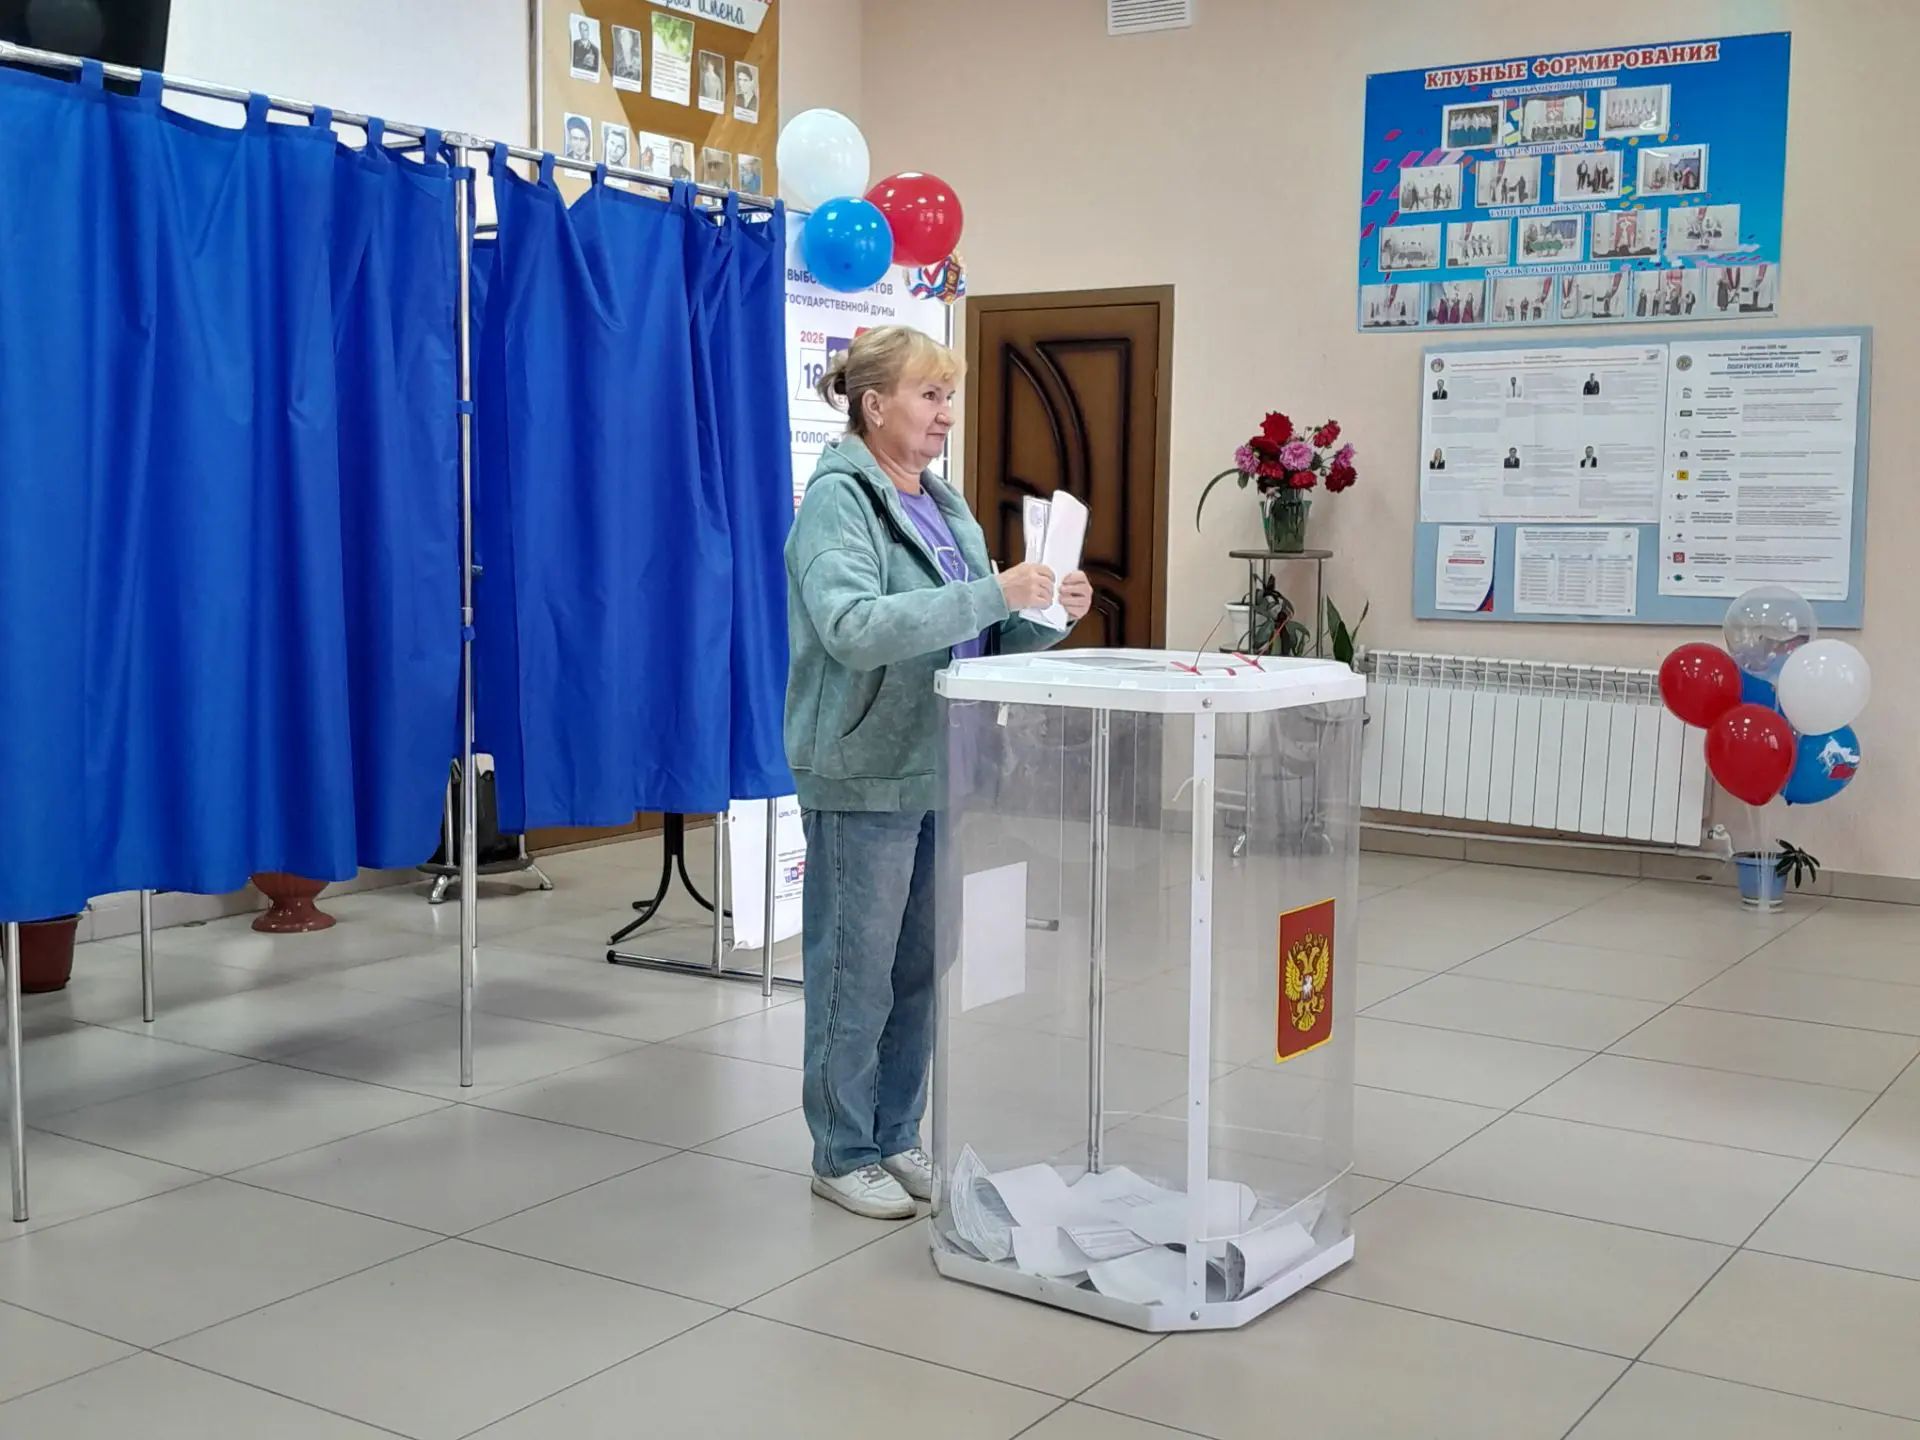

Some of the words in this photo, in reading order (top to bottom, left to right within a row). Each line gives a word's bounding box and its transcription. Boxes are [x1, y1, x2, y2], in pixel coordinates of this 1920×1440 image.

[1426, 63, 1527, 88] КЛУБНЫЕ
[1533, 43, 1718, 77] ФОРМИРОВАНИЯ
[870, 304, 895, 317] ДУМЫ
[800, 330, 825, 344] 2026
[803, 362, 824, 390] 18
[795, 430, 830, 444] ГОЛОС
